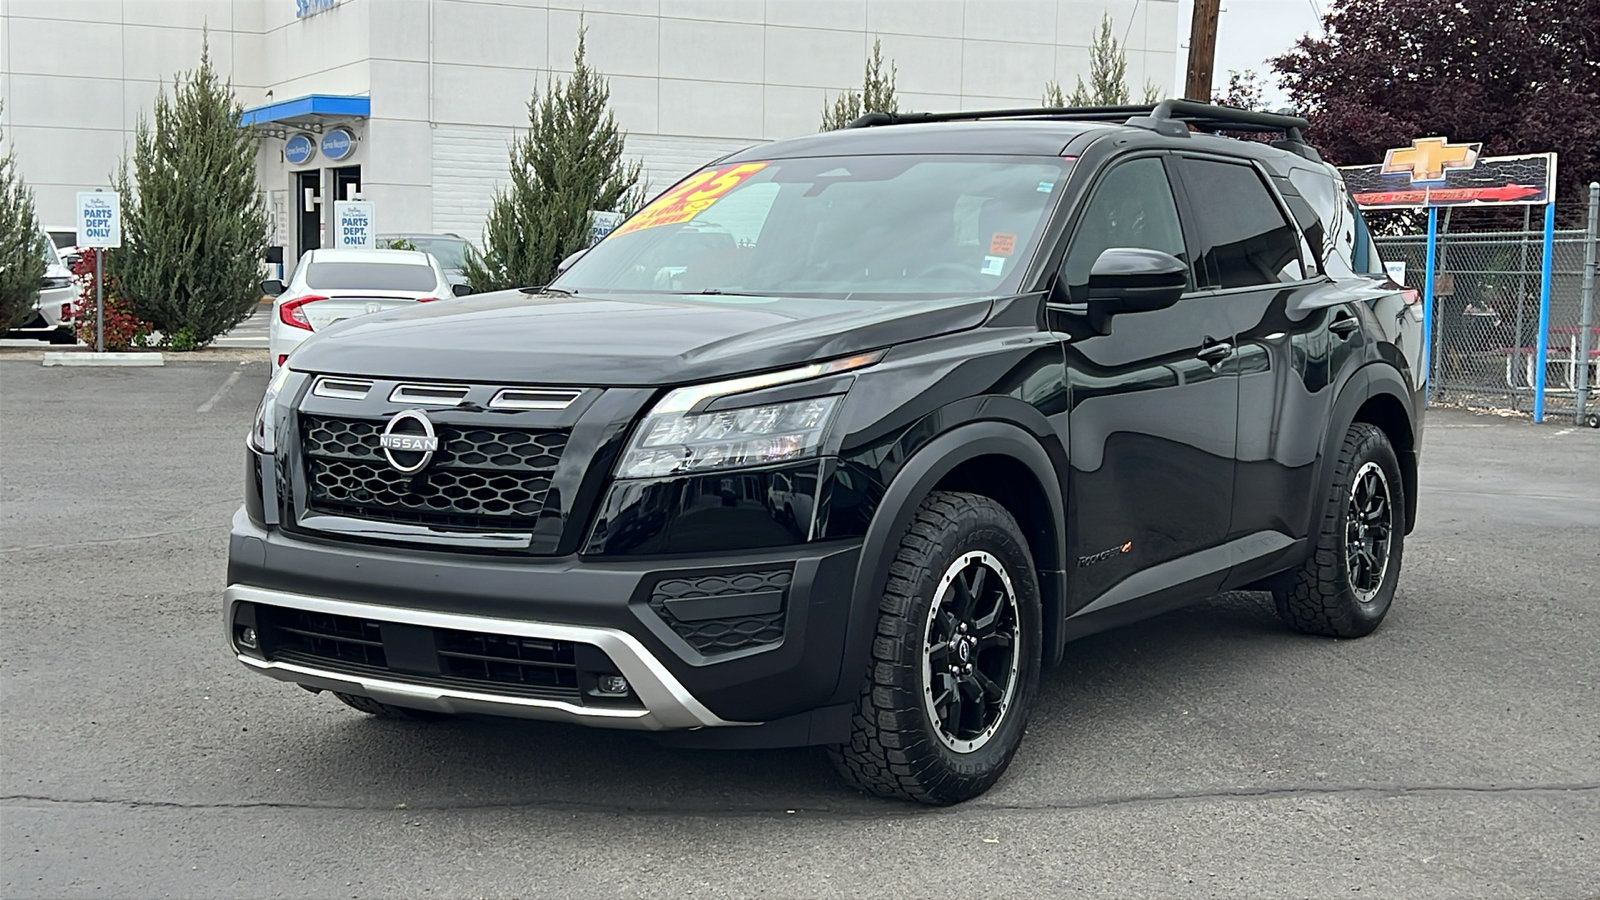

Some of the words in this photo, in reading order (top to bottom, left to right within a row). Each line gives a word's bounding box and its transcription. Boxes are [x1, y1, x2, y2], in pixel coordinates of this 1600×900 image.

[651, 163, 767, 206] 25
[84, 209, 112, 218] PARTS
[86, 219, 110, 227] DEPT.
[342, 218, 368, 226] PARTS
[86, 229, 110, 237] ONLY
[343, 227, 367, 235] DEPT.
[344, 236, 367, 245] ONLY
[380, 437, 436, 450] NISSAN
